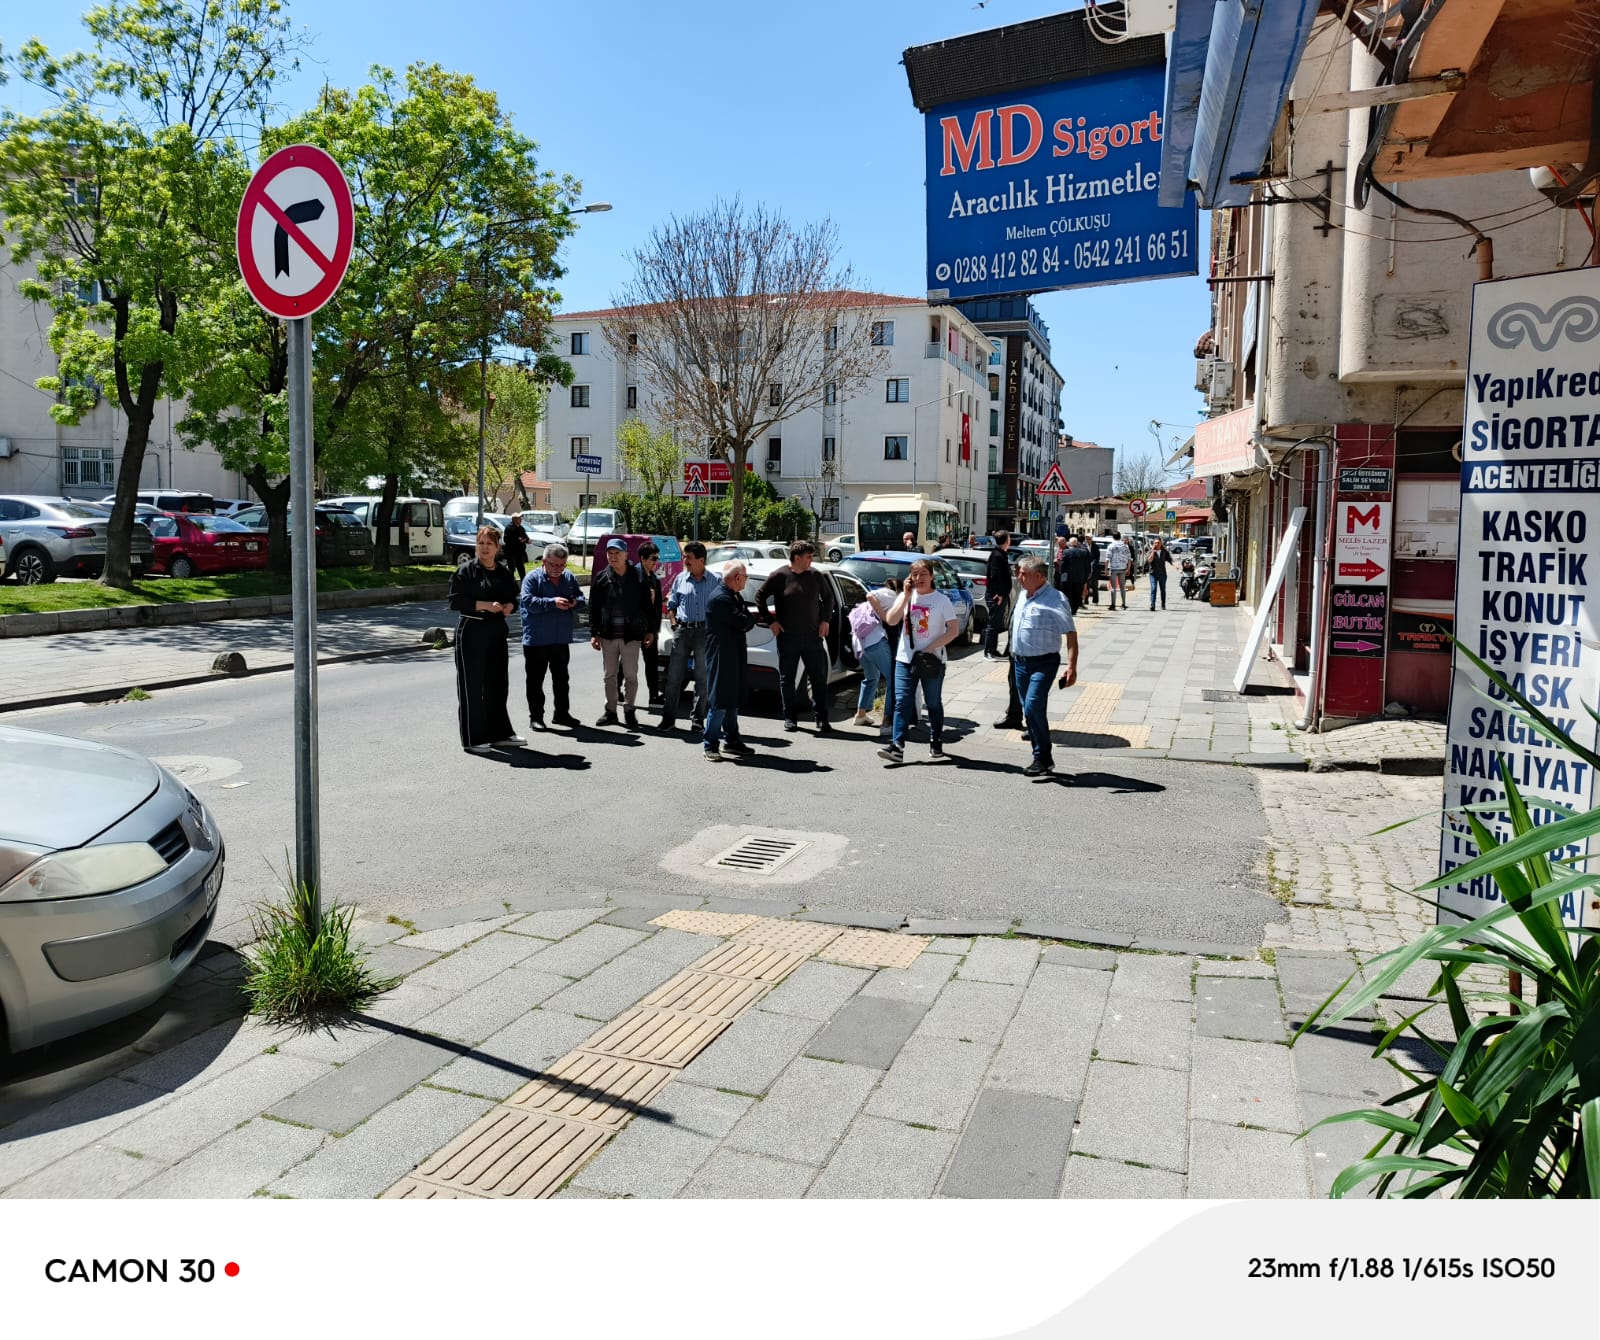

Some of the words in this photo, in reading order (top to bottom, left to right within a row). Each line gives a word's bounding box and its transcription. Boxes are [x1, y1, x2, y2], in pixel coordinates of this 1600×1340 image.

[940, 104, 1044, 176] MD
[1053, 111, 1162, 160] Sigort
[948, 179, 1038, 218] Aracılık
[1046, 162, 1161, 204] Hizmetle
[1006, 226, 1046, 241] Meltem
[1050, 213, 1111, 238] ÇÖLKUŞU
[954, 256, 987, 284] 0288
[991, 251, 1016, 280] 412
[1020, 249, 1037, 276] 82
[1042, 245, 1060, 273] 84
[1074, 239, 1109, 270] 0542
[1114, 235, 1141, 265] 241
[1147, 232, 1166, 261] 66
[1171, 229, 1188, 258] 51
[1470, 412, 1600, 452] SİGORTA
[1482, 510, 1587, 543] KASKO
[1479, 547, 1588, 586] TRAFİK
[1333, 590, 1385, 608] GÜLCAN
[1482, 590, 1586, 627] KONUT
[1332, 613, 1384, 630] BUTİK
[1479, 625, 1582, 668] İŞYERİ
[1487, 669, 1573, 710] DASK
[1451, 743, 1588, 795] NAKLİYAT
